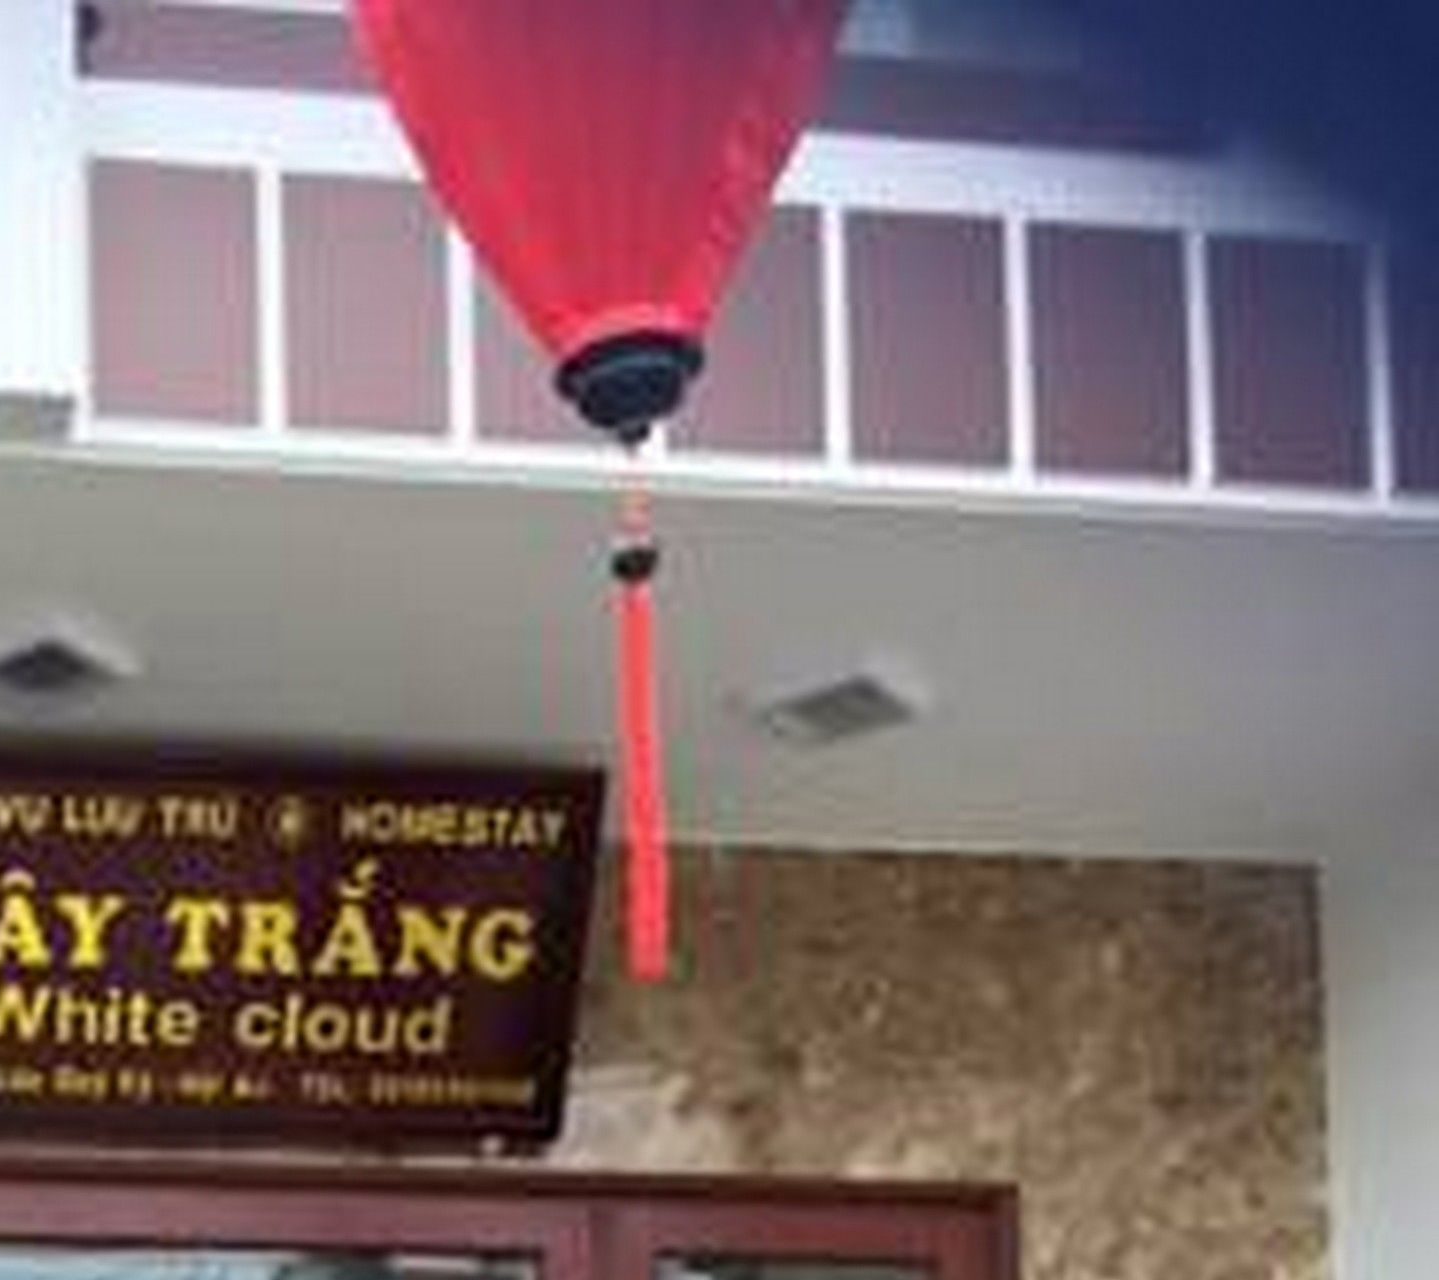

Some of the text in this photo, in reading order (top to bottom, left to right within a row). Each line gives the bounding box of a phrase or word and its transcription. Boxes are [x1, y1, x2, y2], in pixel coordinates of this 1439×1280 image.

[340, 800, 568, 849] HOMESTAY
[165, 857, 535, 981] TRẮNG
[234, 993, 453, 1054] cloud
